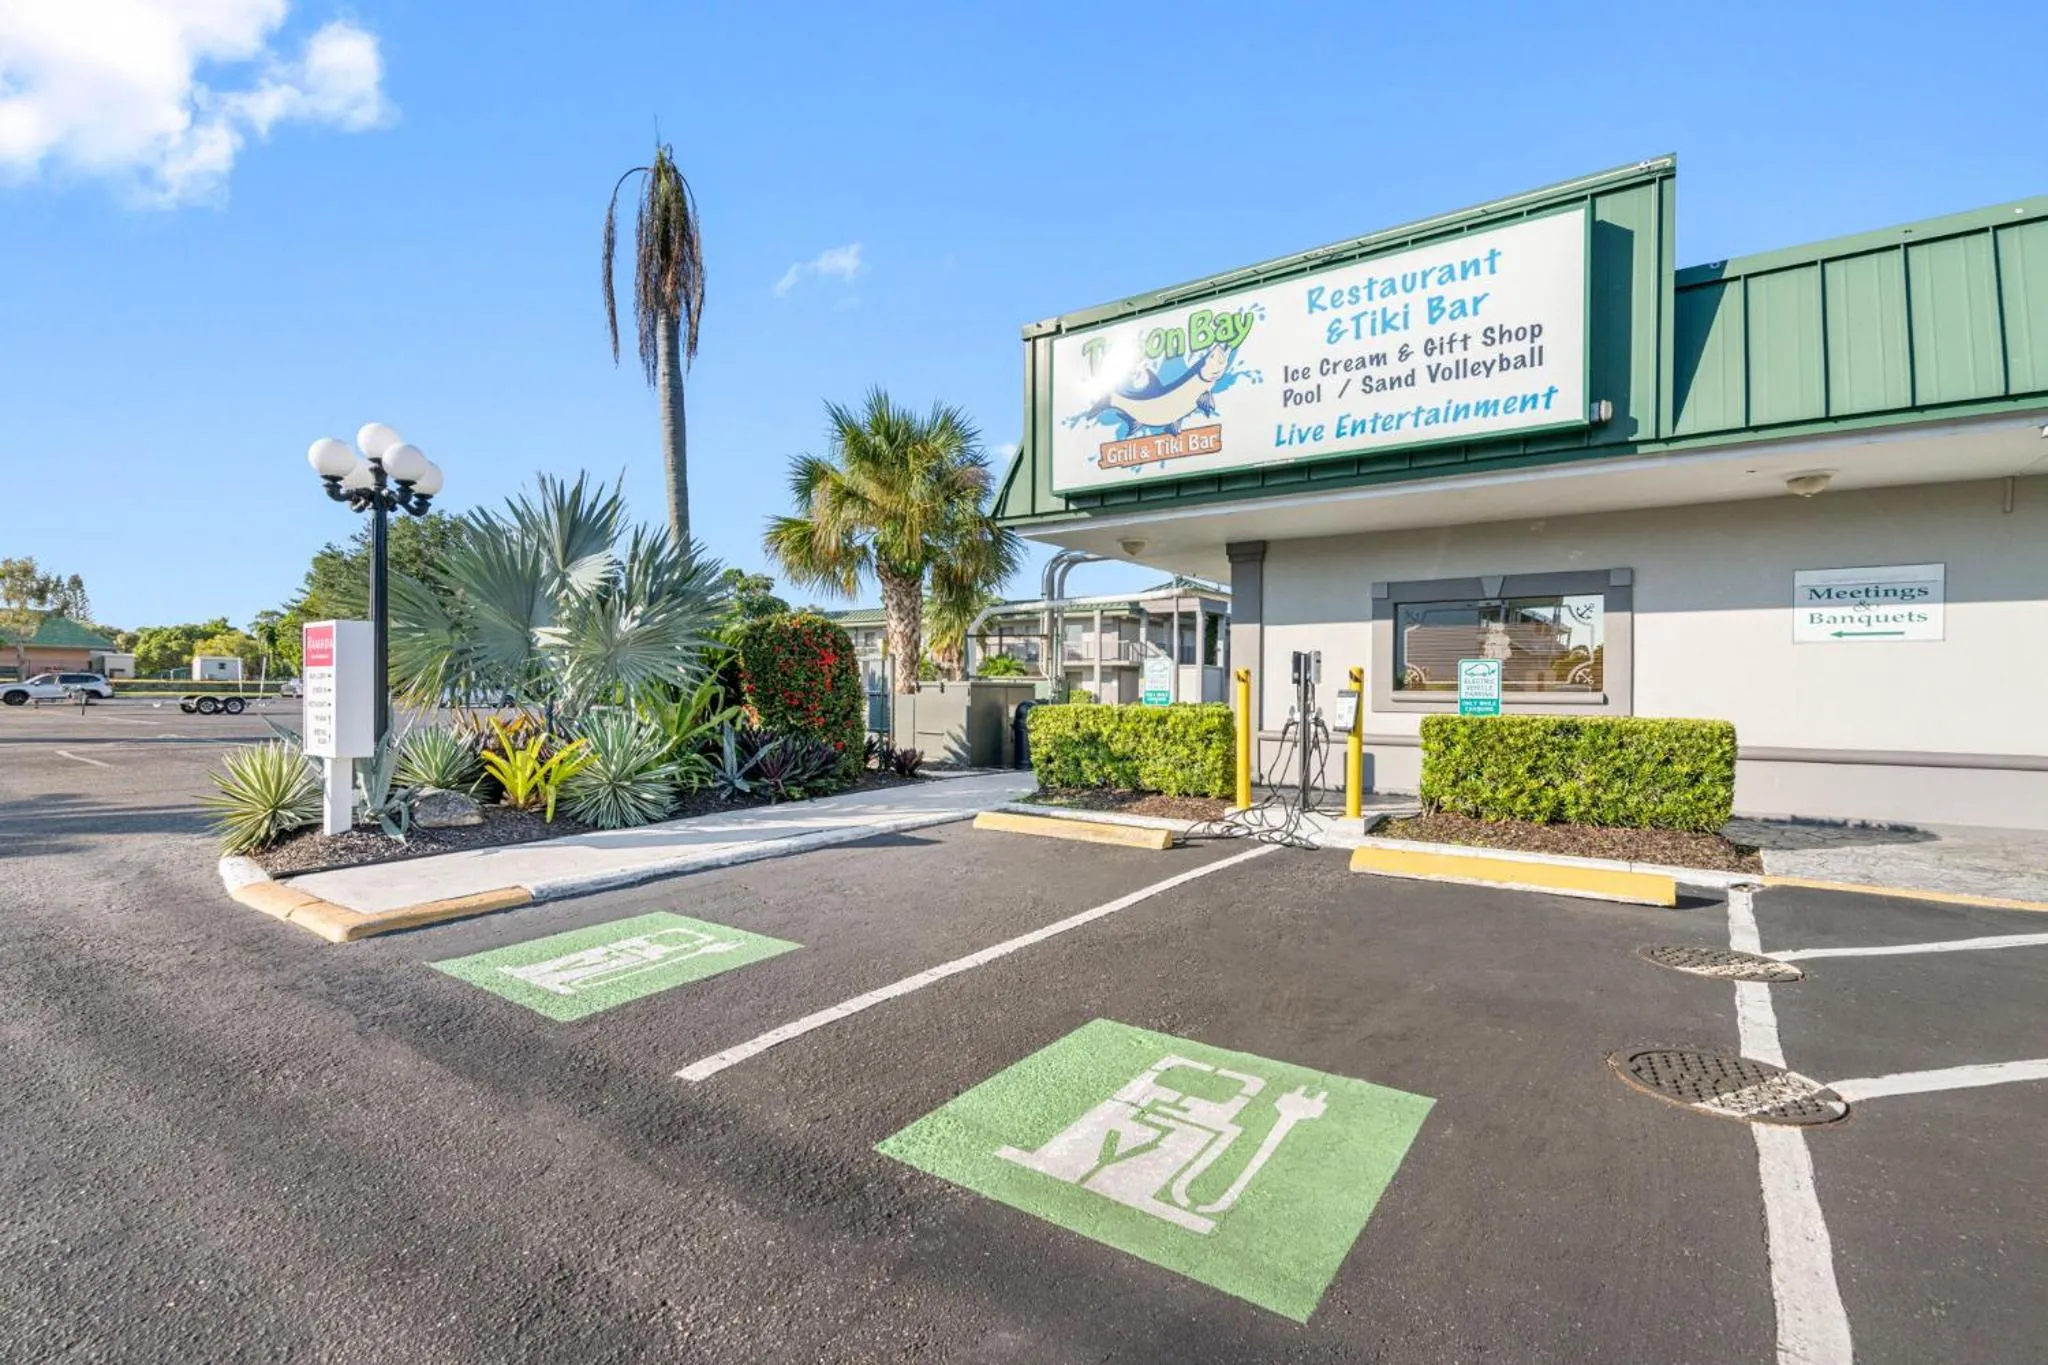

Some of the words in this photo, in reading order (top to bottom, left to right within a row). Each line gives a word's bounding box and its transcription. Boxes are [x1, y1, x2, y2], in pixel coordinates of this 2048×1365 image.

[1307, 248, 1502, 315] Restaurant
[1188, 309, 1255, 353] Bay
[1426, 292, 1490, 326] Bar
[1283, 364, 1311, 384] Ice
[1319, 350, 1388, 376] Cream
[1398, 343, 1414, 362] &
[1424, 331, 1472, 357] Gift
[1481, 323, 1544, 347] Shop
[1283, 383, 1322, 408] Pool
[1338, 378, 1352, 399] /
[1361, 368, 1416, 395] Sand
[1426, 345, 1545, 384] Volleyball
[1274, 423, 1325, 448] Live
[1335, 385, 1559, 439] Entertainment
[1107, 443, 1137, 464] Grill
[1140, 446, 1150, 459] &
[1154, 436, 1184, 457] Tiki
[1188, 433, 1217, 451] Bar
[1808, 585, 1930, 601] Meetings
[1808, 610, 1929, 628] Banquets
